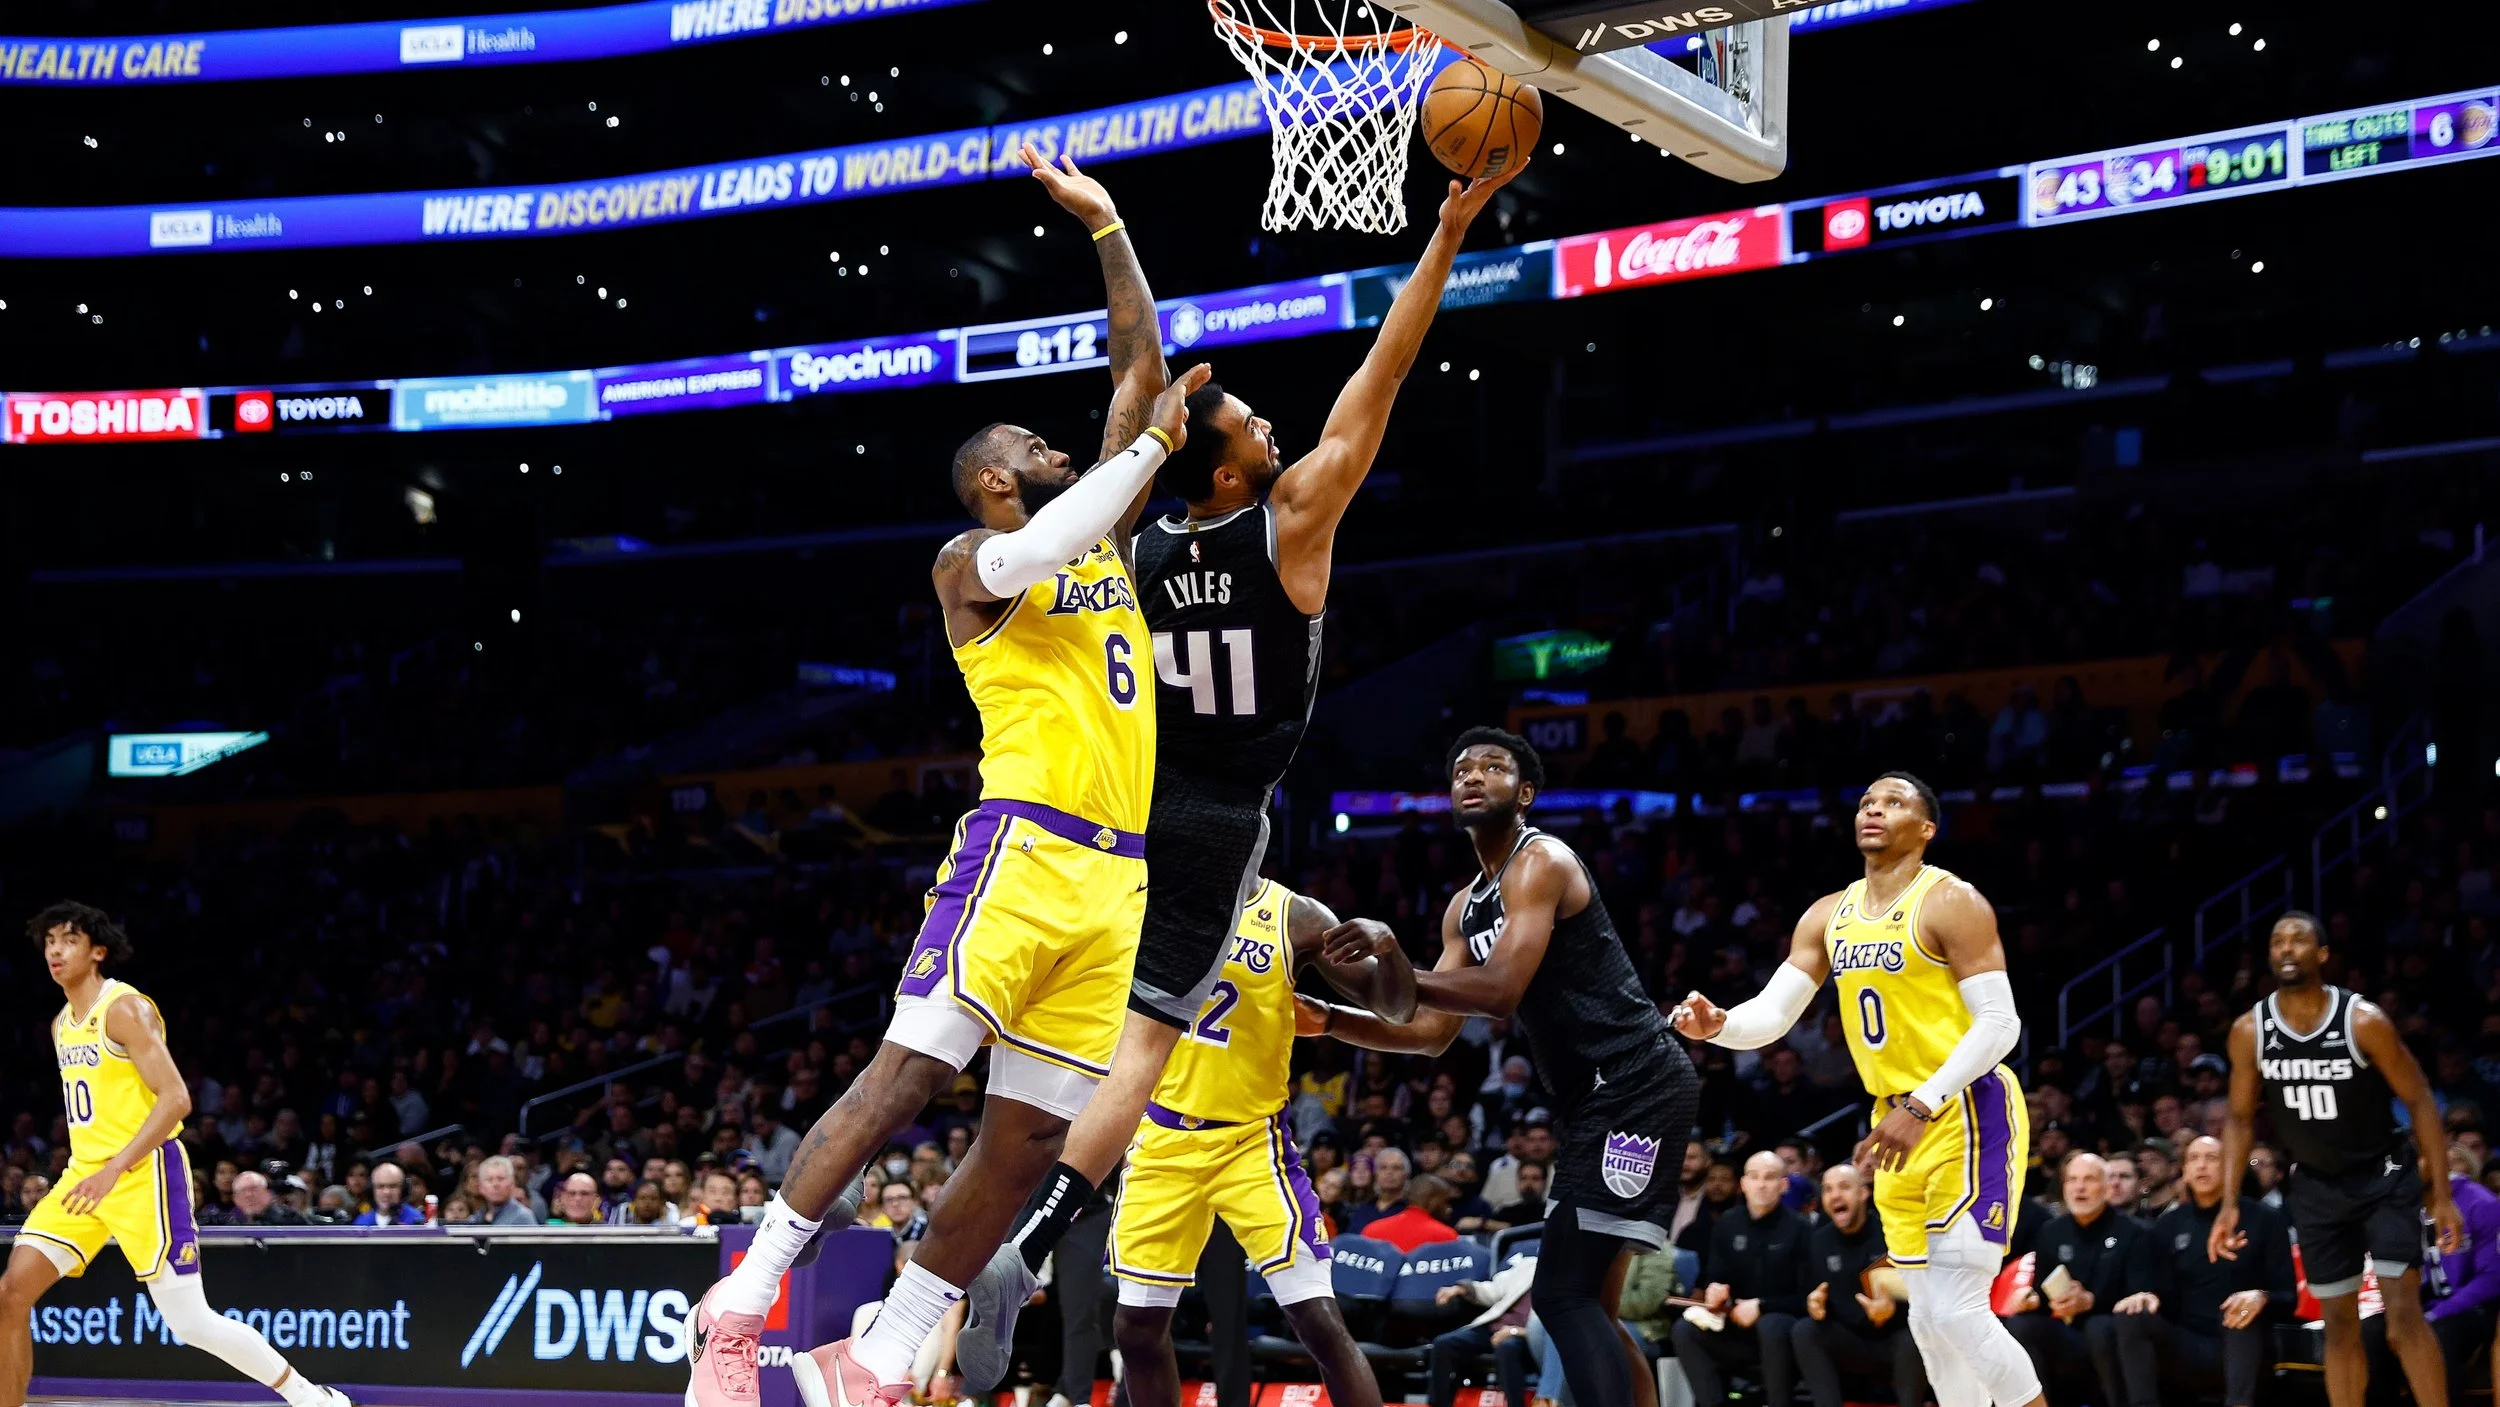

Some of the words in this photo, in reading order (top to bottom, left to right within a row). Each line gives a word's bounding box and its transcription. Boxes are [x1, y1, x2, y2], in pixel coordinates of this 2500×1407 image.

[467, 26, 536, 54] Health
[669, 0, 770, 42] WHERE
[1614, 6, 1734, 40] DWS
[0, 43, 119, 80] HEALTH
[122, 40, 206, 79] CARE
[2429, 112, 2454, 147] 6
[422, 194, 533, 236] WHERE
[535, 177, 698, 228] DISCOVERY
[699, 161, 795, 211] LEADS
[799, 156, 838, 198] TO
[842, 124, 1059, 191] WORLD-CLASS
[1062, 101, 1180, 159] HEALTH
[1180, 90, 1264, 139] CARE
[2206, 138, 2285, 185] 9:01
[2329, 141, 2382, 171] LEFT
[2055, 169, 2101, 207] 43
[2129, 157, 2177, 197] 34
[216, 212, 283, 239] Health
[1876, 192, 1985, 231] TOYOTA
[1204, 294, 1328, 335] crypto.com
[1016, 323, 1098, 367] 8:12
[601, 377, 686, 403] AMERICAN
[687, 367, 763, 394] EXPRESS
[790, 344, 933, 392] Spectrum
[14, 397, 194, 436] TOSHIBA
[276, 396, 364, 420] TOYOTA
[425, 381, 568, 413] mobilitie
[1163, 571, 1232, 610] LYLES
[1104, 632, 1136, 705] 6
[1151, 628, 1257, 715] 41
[1250, 919, 1277, 932] bibigo
[1226, 936, 1275, 974] ERS
[1833, 939, 1905, 978] LAKERS
[1859, 988, 1885, 1044] 0
[2260, 1058, 2354, 1080] KINGS
[64, 1080, 93, 1123] 10
[2282, 1084, 2338, 1120] 40
[1605, 1155, 1651, 1176] KINGS
[1334, 1250, 1384, 1274] DELTA
[1416, 1255, 1474, 1275] DELTA
[134, 1292, 411, 1350] Mgement
[532, 1288, 690, 1364] DWS
[757, 1345, 793, 1367] OTA
